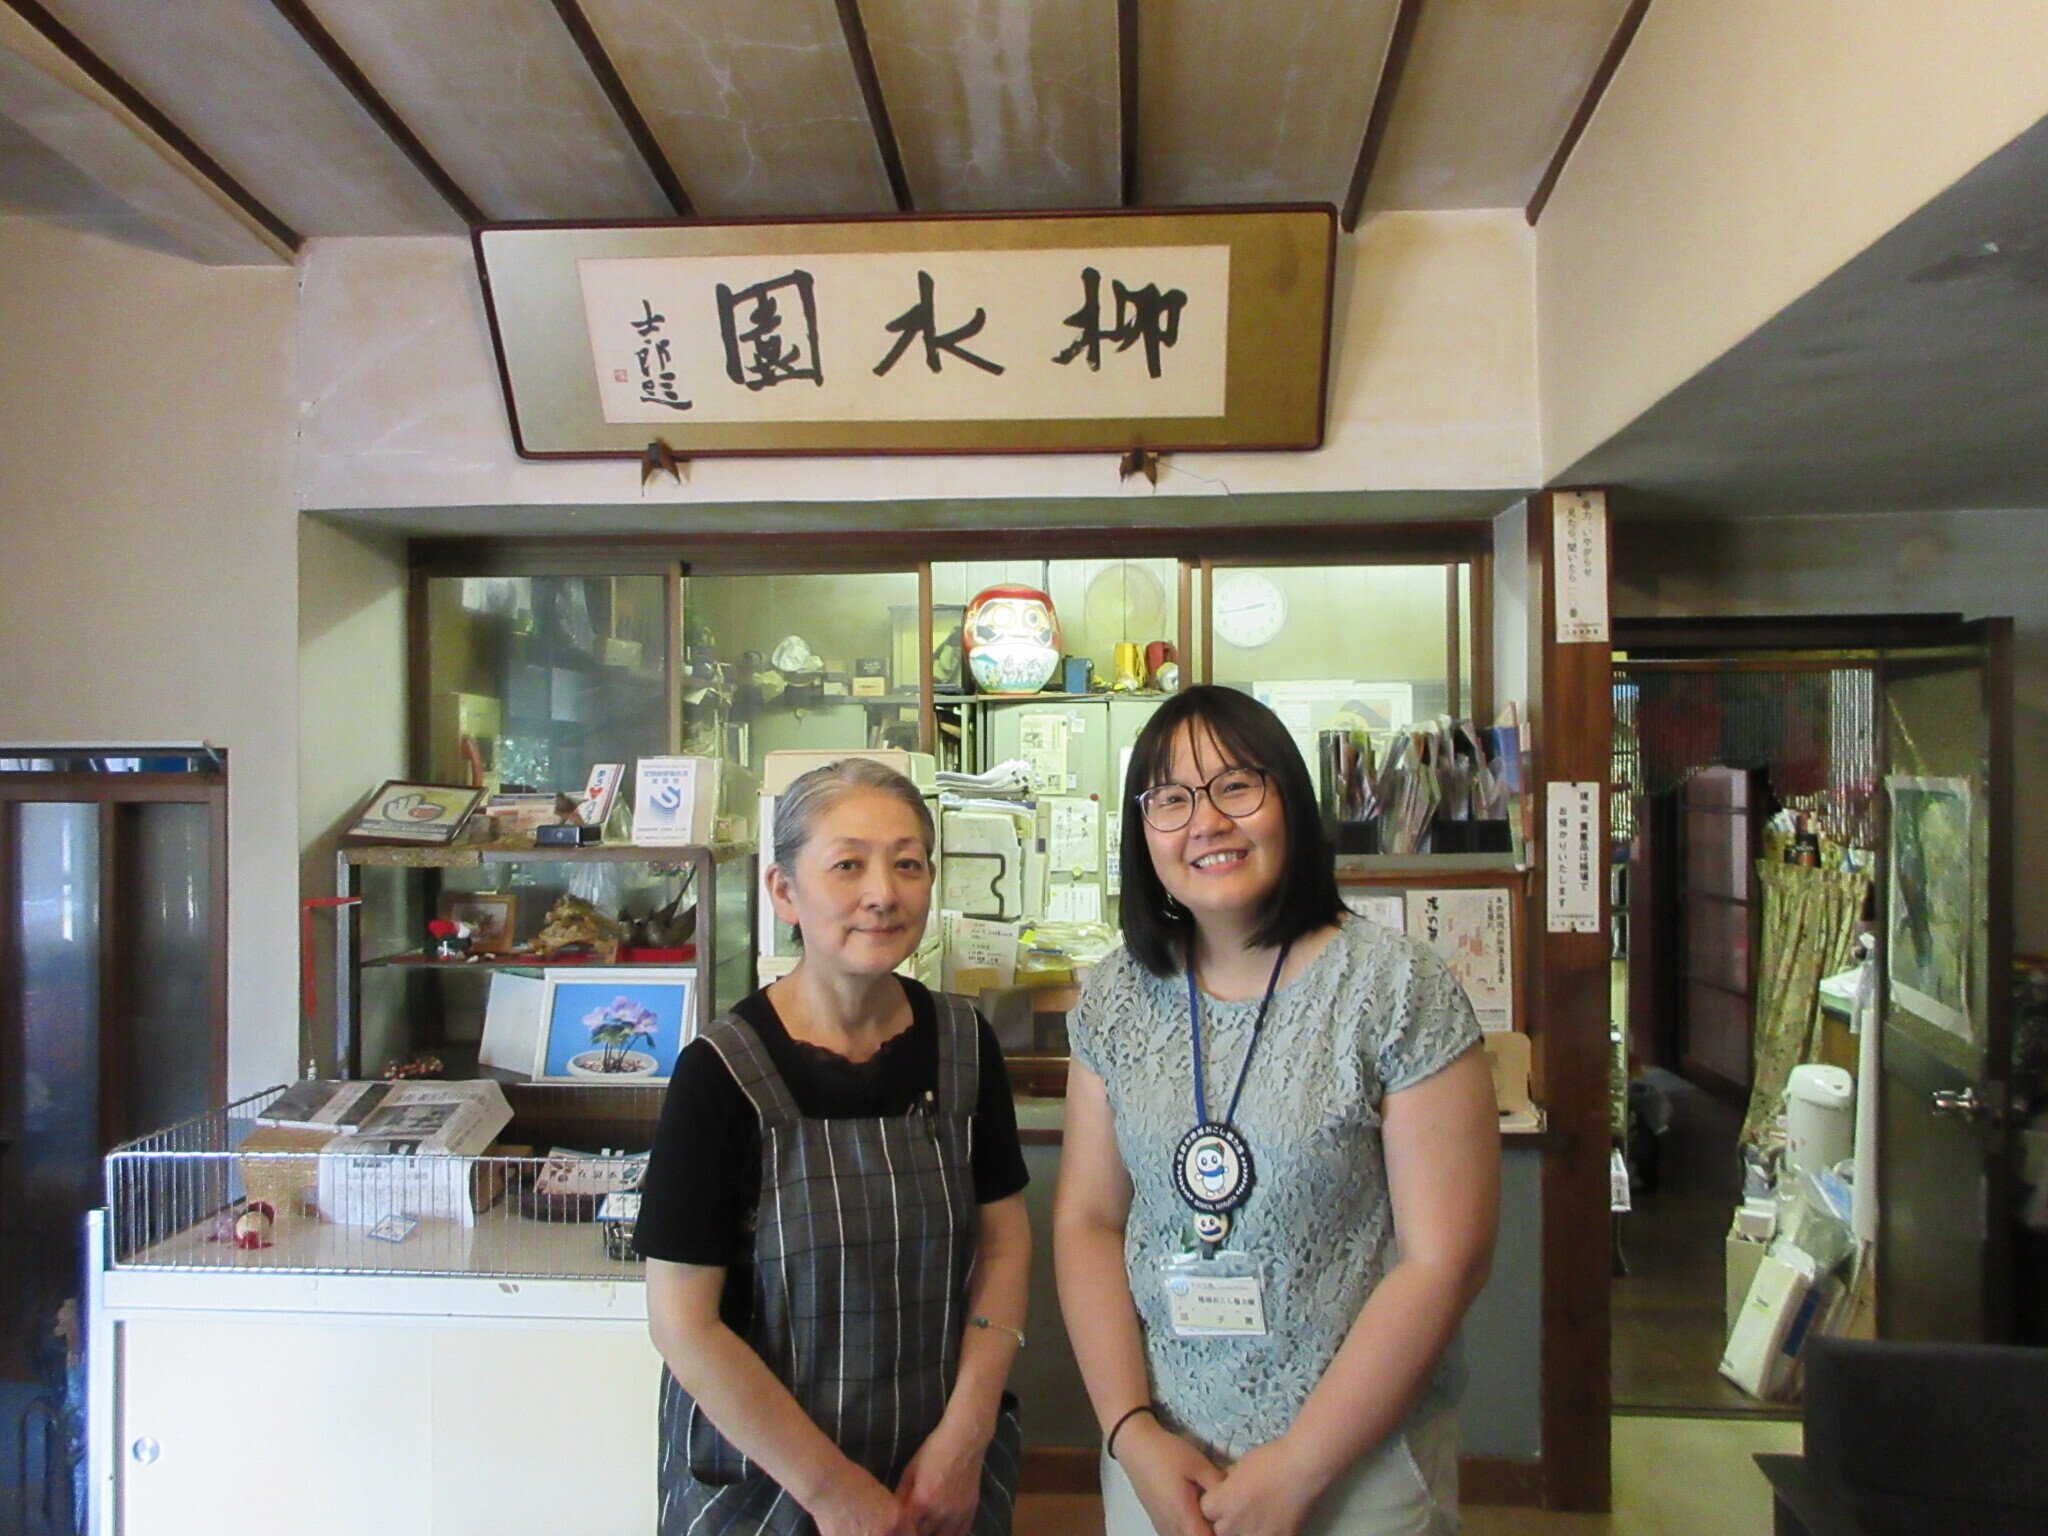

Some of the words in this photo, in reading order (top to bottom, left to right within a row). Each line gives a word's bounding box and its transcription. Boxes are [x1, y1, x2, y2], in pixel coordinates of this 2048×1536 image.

[1558, 806, 1567, 907] お預かりいたします
